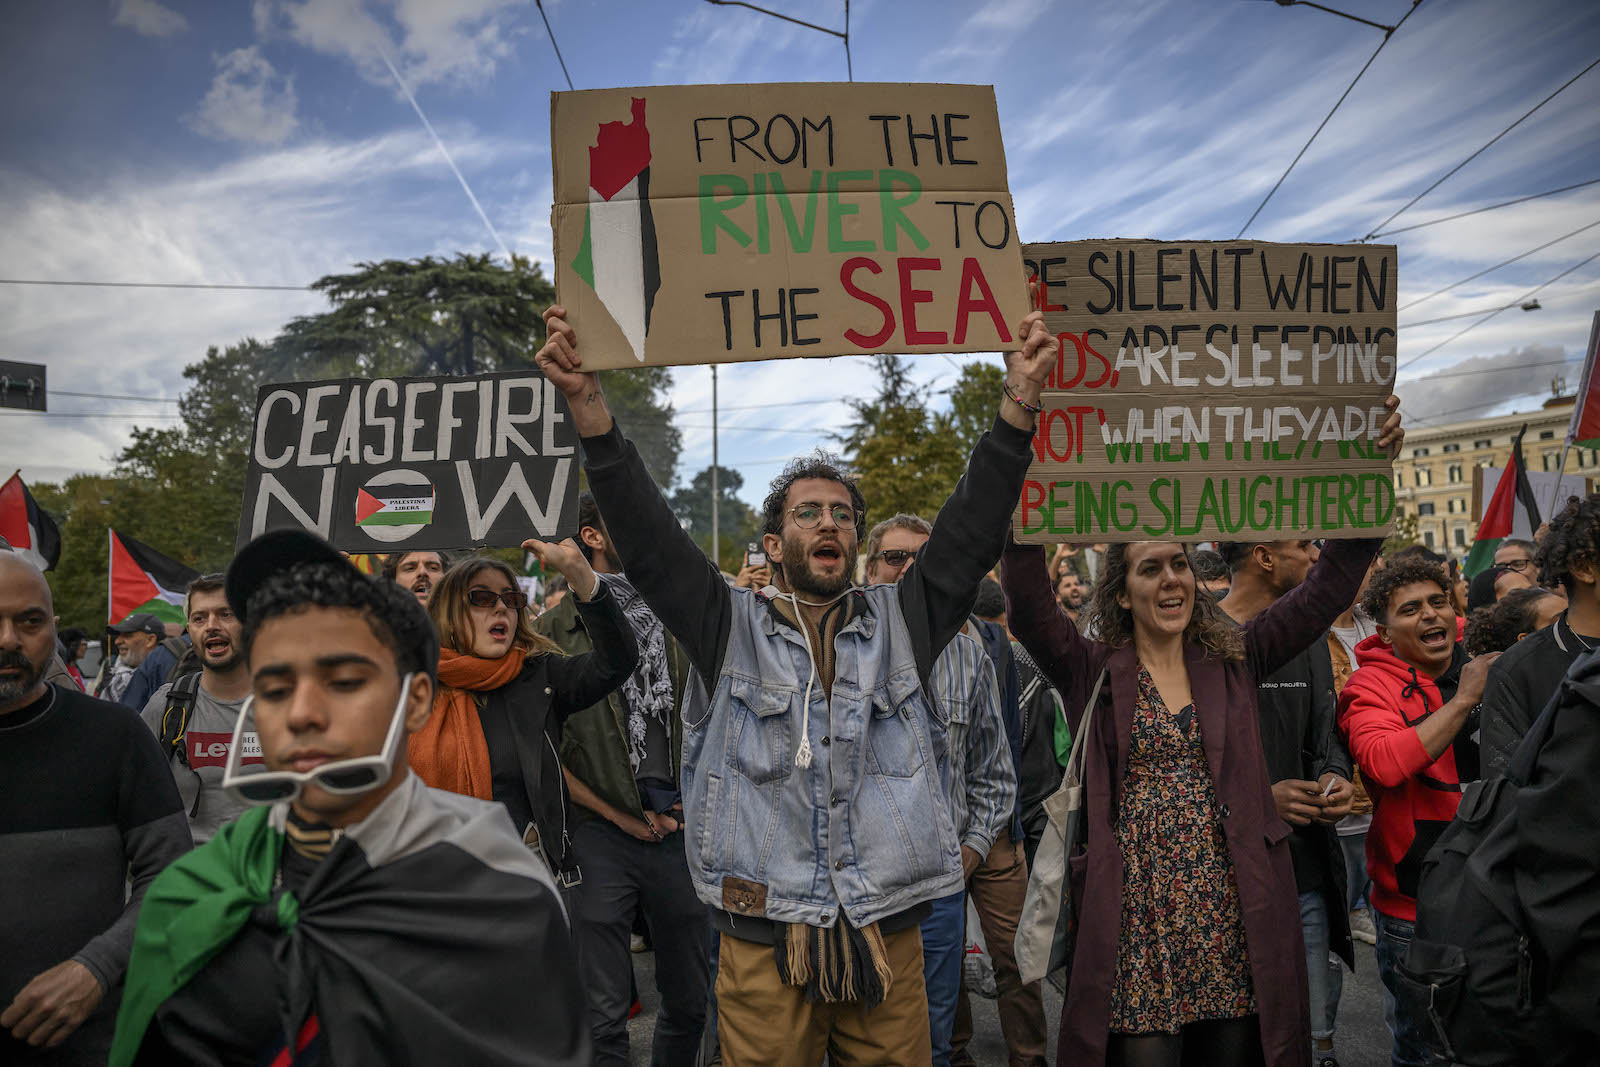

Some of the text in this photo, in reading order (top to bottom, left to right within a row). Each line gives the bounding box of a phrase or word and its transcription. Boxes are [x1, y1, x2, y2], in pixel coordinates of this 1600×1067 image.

[694, 113, 978, 167] FROM THE
[699, 168, 931, 255] RIVER
[935, 199, 1010, 249] TO
[705, 256, 1013, 350] THE SEA
[1086, 248, 1253, 315] SILENT
[1260, 252, 1388, 314] WHEN
[1041, 323, 1396, 390] DS ARE SLEEPING
[254, 378, 575, 470] CEASEFIRE
[1031, 406, 1095, 464] NOT
[1097, 406, 1210, 464] WHEN
[1214, 405, 1322, 461] THEY
[251, 458, 572, 543] NOW
[1021, 472, 1396, 535] BEING SLAUGHTERED
